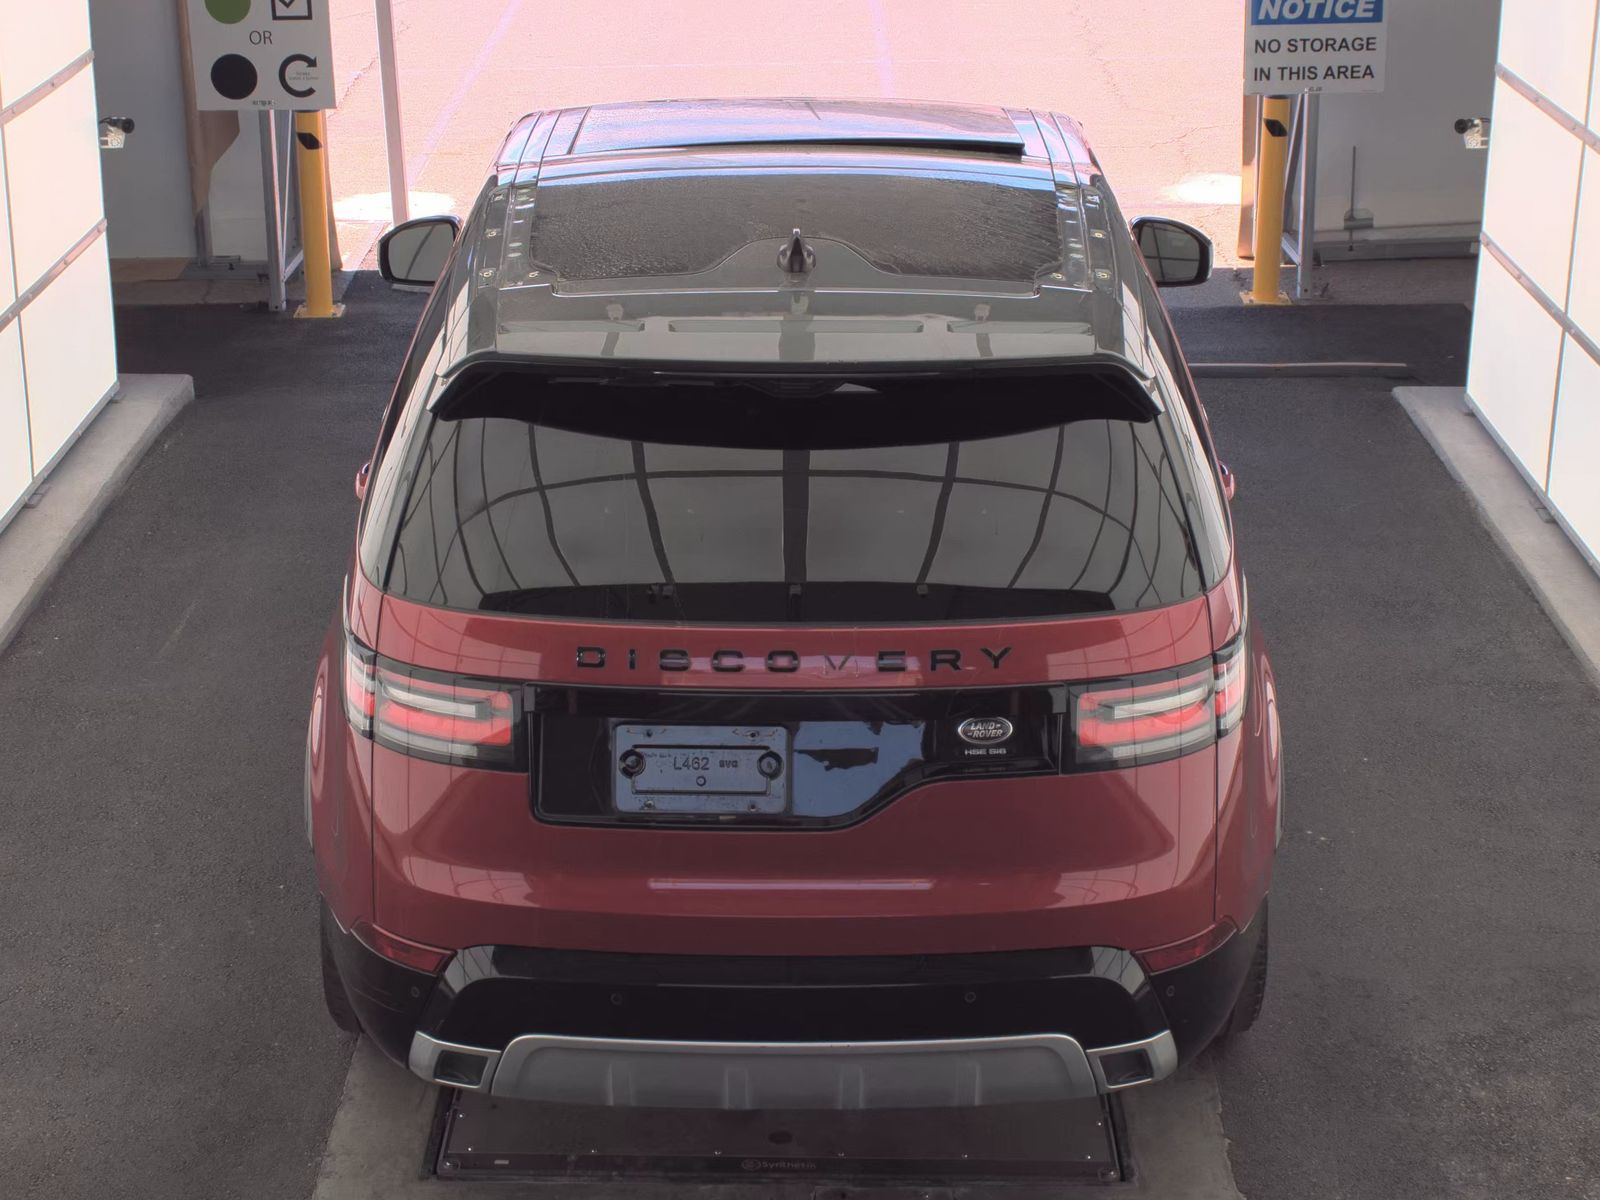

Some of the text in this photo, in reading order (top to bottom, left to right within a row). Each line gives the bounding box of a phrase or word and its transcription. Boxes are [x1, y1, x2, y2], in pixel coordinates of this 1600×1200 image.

[1258, 0, 1376, 20] NOTICE
[249, 30, 273, 45] OR
[1255, 37, 1377, 53] NO STORAGE
[1254, 65, 1375, 81] IN THIS AREA
[576, 646, 1012, 673] DISCOVERY
[673, 756, 710, 770] L462
